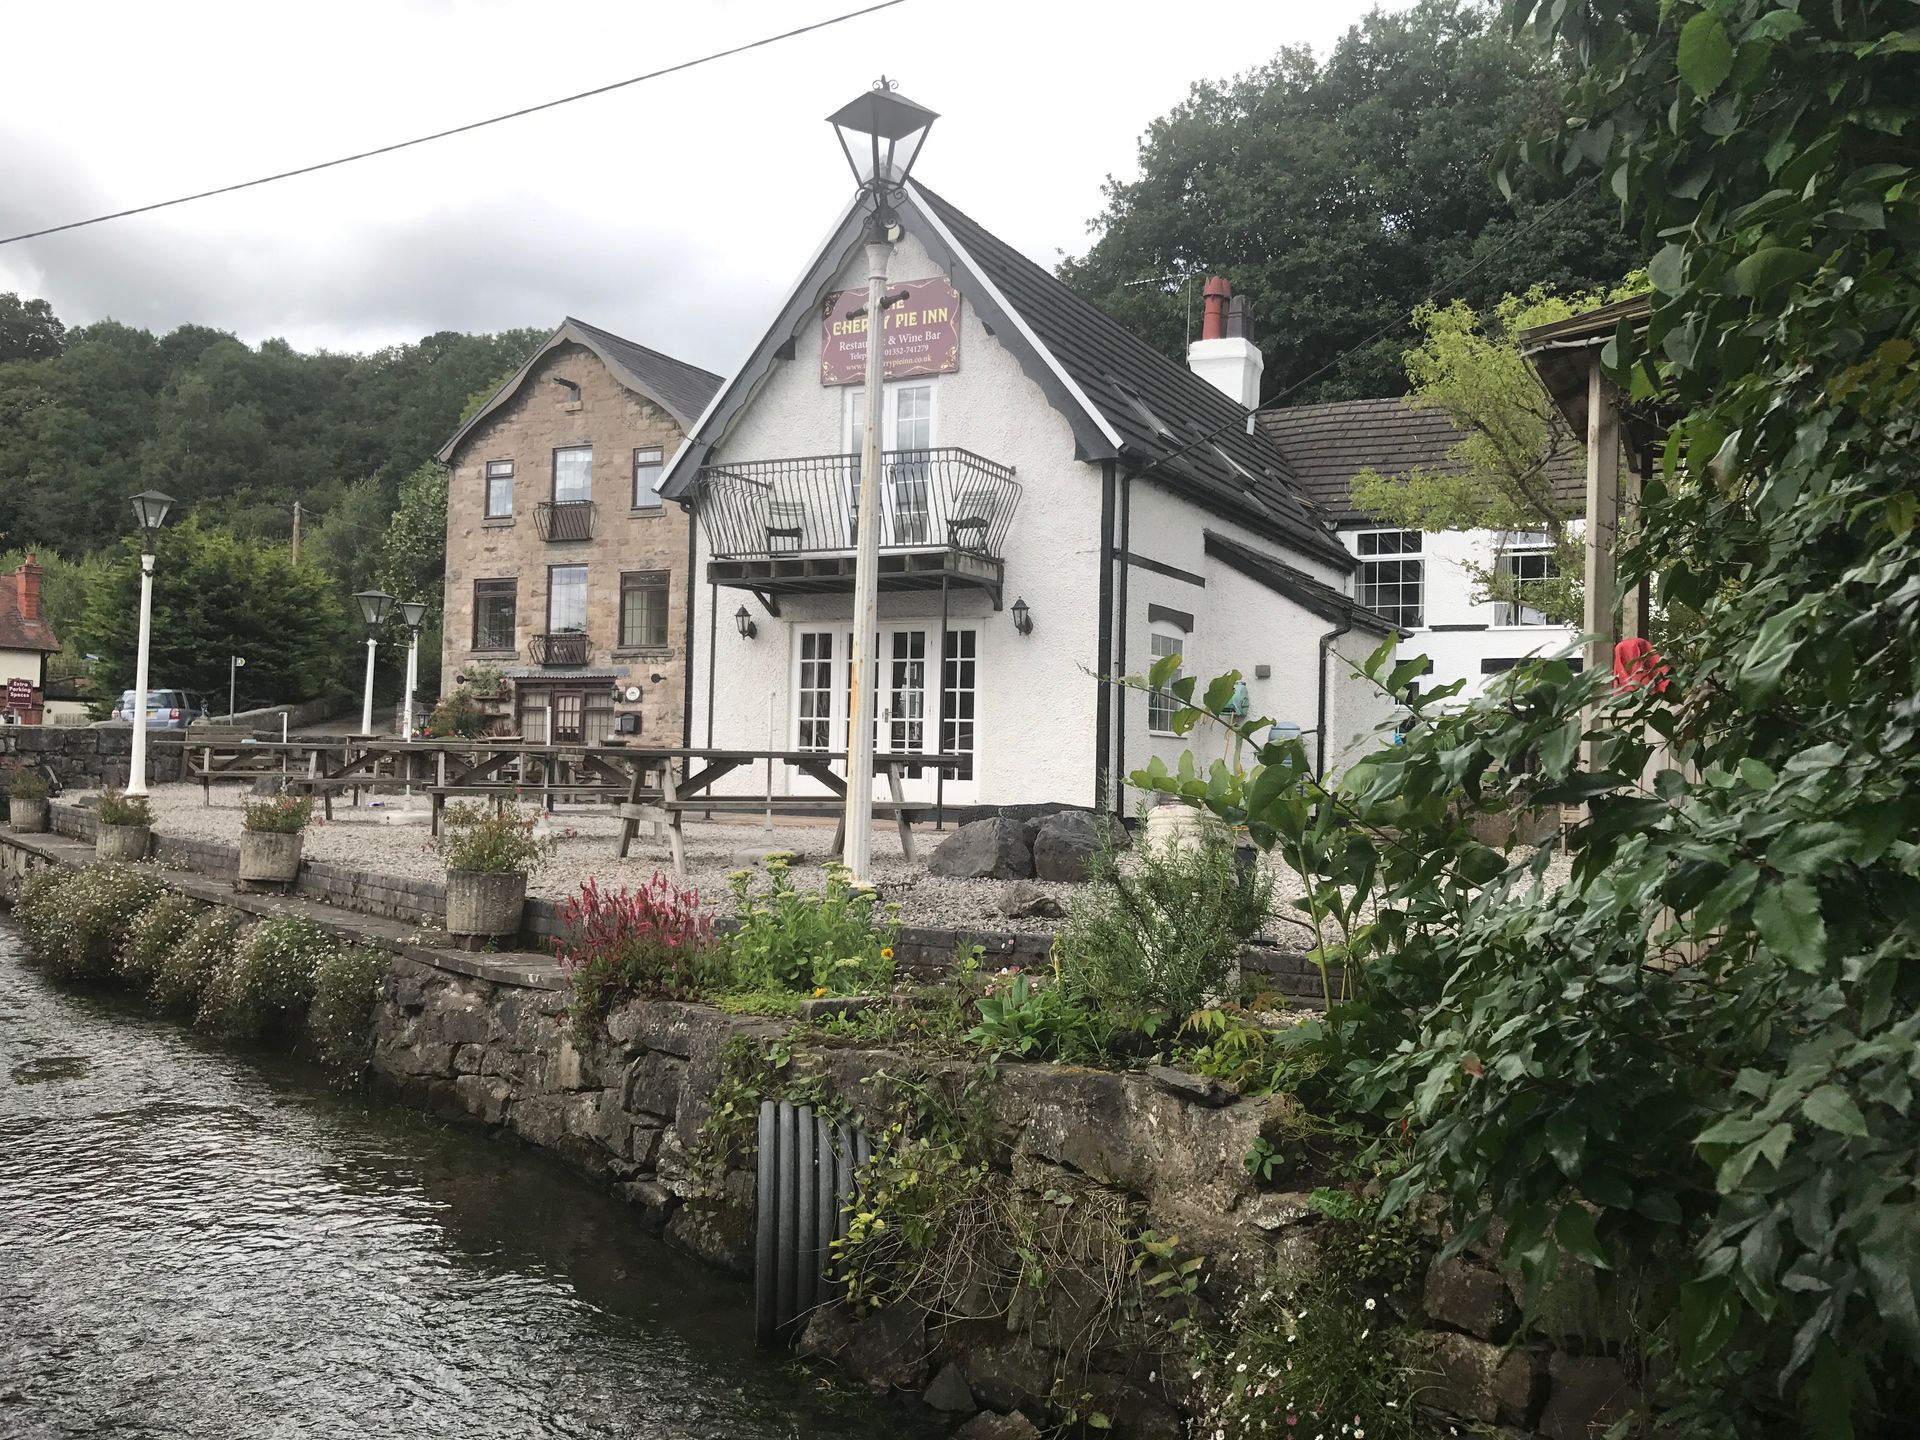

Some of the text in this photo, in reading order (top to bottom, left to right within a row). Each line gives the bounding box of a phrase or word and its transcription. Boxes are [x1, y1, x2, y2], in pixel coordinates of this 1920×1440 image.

[833, 308, 948, 335] CHERY PIE INN
[839, 331, 942, 351] Restau & Wine Bar
[884, 345, 929, 356] 01352-741279
